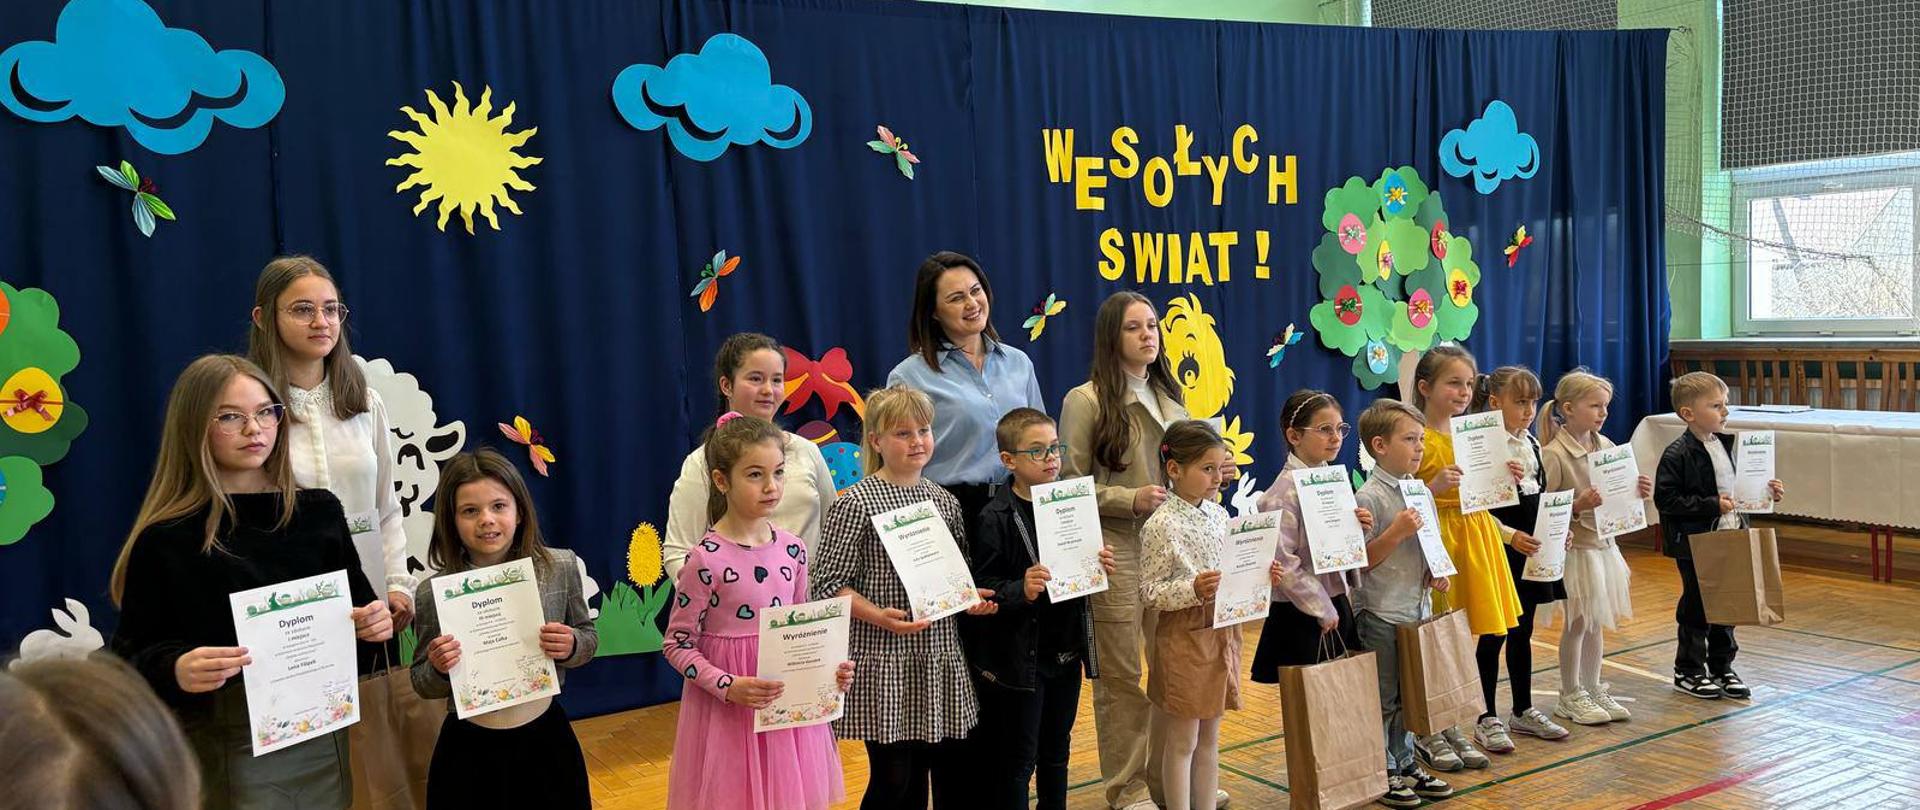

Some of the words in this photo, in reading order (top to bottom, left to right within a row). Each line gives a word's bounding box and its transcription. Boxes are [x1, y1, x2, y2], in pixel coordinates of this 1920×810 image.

[1043, 125, 1297, 210] WESOŁYCH
[471, 597, 503, 609] Dyplom
[279, 614, 314, 628] Dyplom
[782, 628, 828, 641] Wyróżnienie
